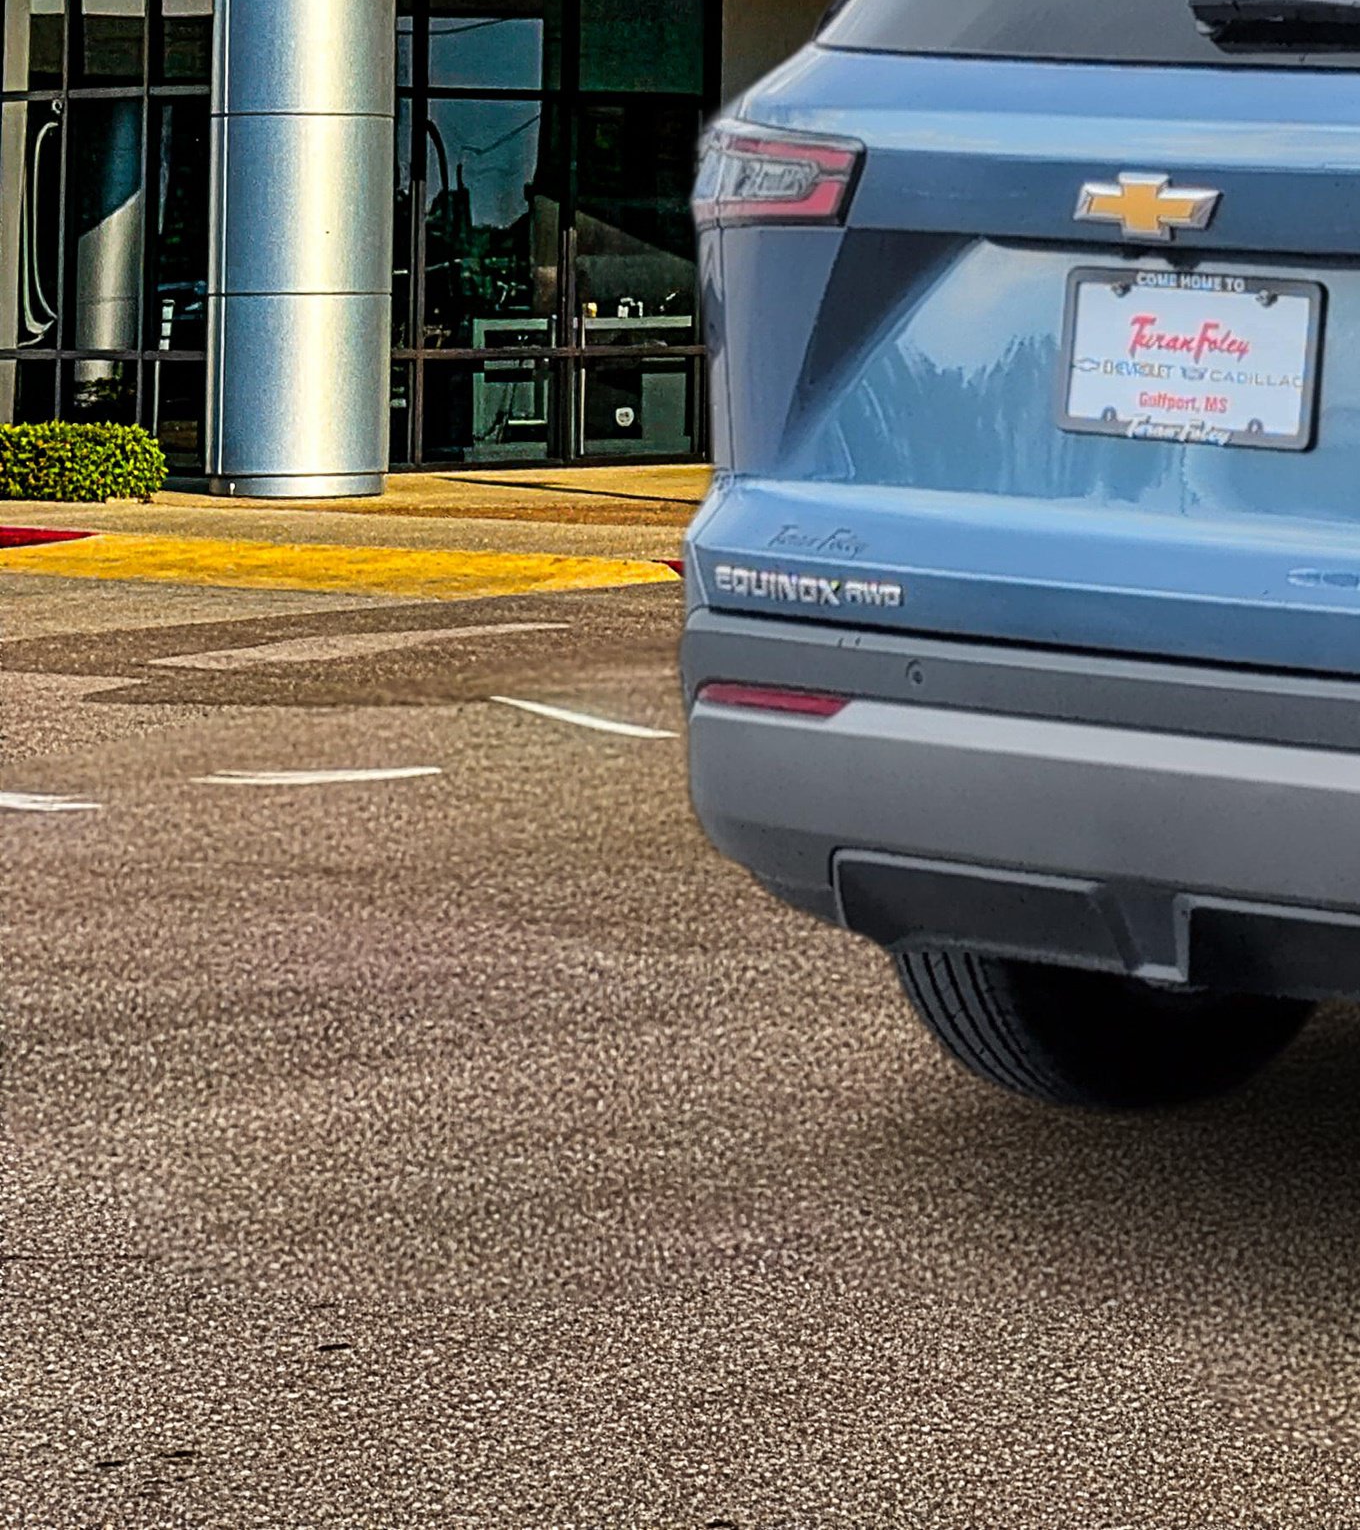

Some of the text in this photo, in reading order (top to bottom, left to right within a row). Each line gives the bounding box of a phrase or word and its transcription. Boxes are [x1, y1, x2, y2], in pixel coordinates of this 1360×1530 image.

[1136, 272, 1246, 293] COME HOME TO
[1209, 369, 1304, 388] CADILLAC
[1204, 396, 1229, 413] MS
[715, 565, 842, 607] EQUINOX
